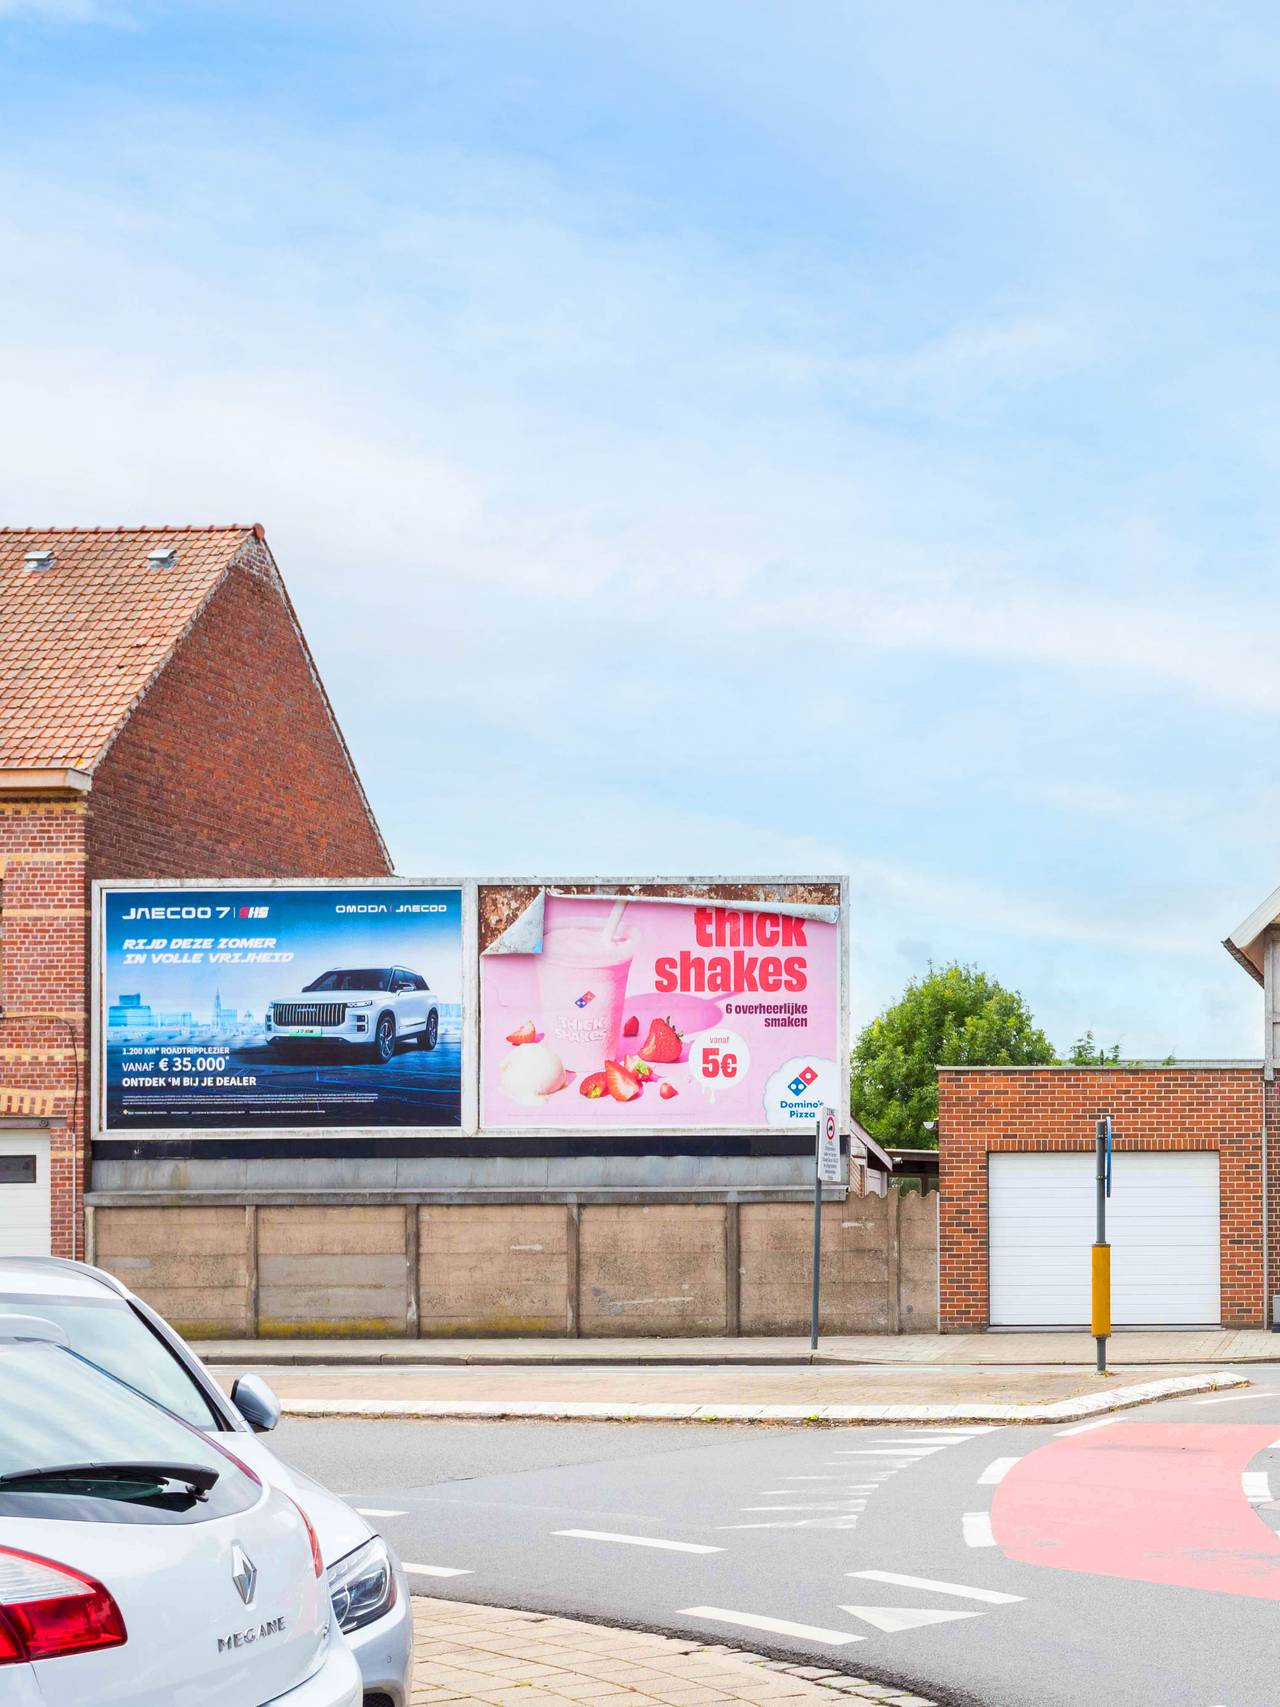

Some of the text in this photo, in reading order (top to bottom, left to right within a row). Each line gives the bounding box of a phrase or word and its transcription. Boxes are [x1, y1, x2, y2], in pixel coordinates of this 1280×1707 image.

[122, 907, 212, 920] JAECOO
[215, 906, 231, 919] 7
[335, 904, 447, 913] OMODA JAECOO
[694, 907, 808, 948] thick
[122, 938, 277, 950] RIJD DEZE ZOMER
[122, 952, 294, 965] IN VOLLE VRIJHEID
[654, 950, 808, 993] shakes
[725, 1002, 808, 1016] 6 overheerlijke
[764, 1016, 808, 1028] smaken
[122, 1062, 155, 1072] VANAF
[159, 1058, 169, 1071] €
[702, 1047, 738, 1078] 5€
[122, 1078, 167, 1087] ONTDEK
[183, 1077, 199, 1086] BIJ
[201, 1077, 214, 1086] JE
[216, 1077, 257, 1086] DEALER
[789, 1110, 816, 1118] Pizza
[217, 1616, 286, 1653] MEGANE
